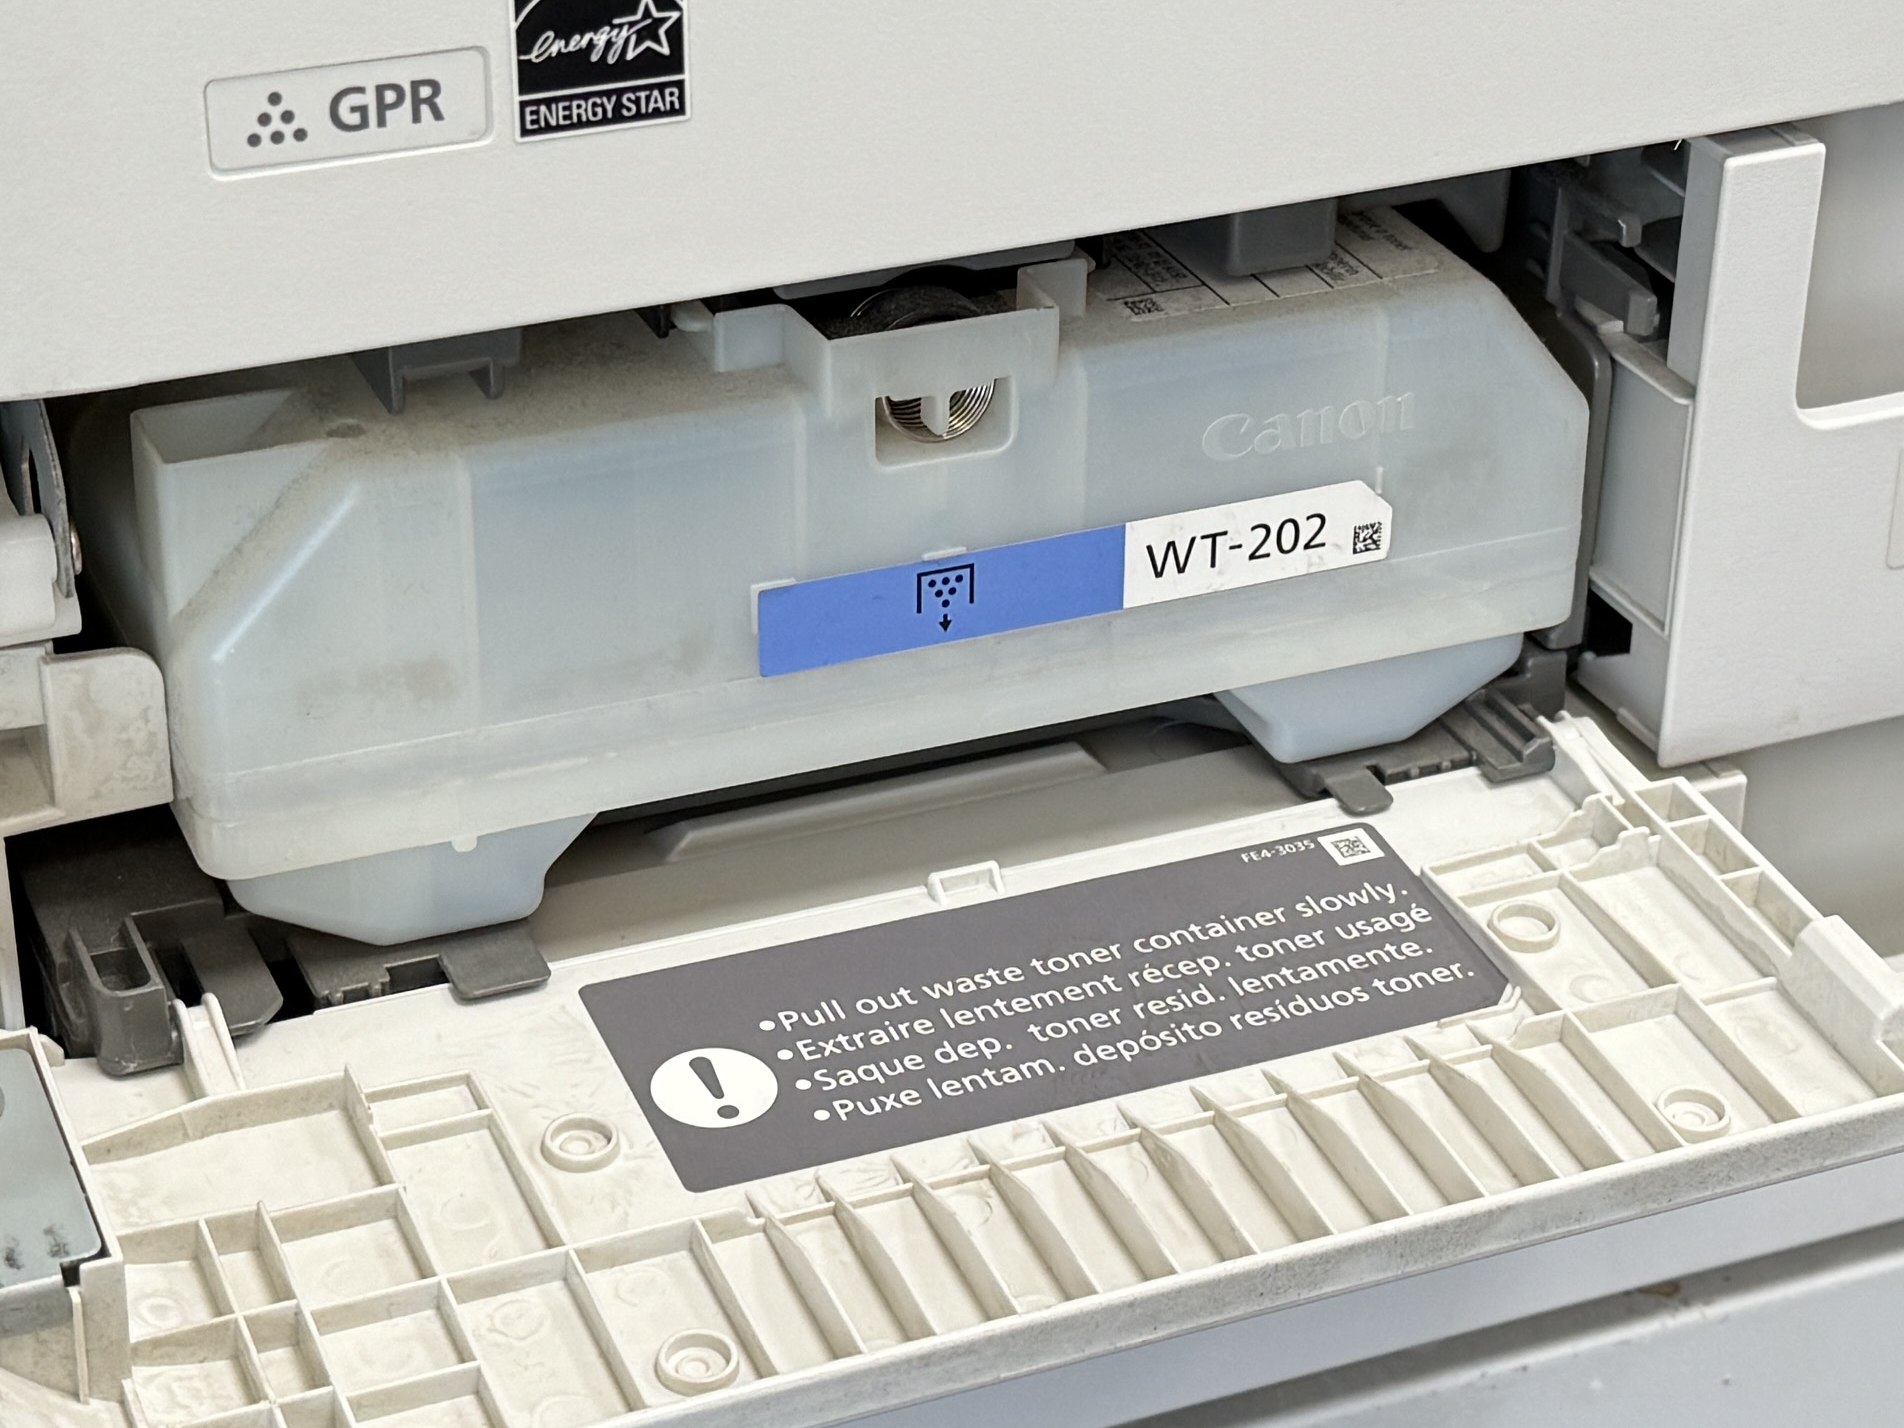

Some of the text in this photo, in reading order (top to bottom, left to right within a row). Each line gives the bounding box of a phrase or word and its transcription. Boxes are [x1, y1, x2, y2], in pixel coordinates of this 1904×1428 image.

[329, 79, 445, 132] GPR
[525, 88, 680, 130] ENERGY STAR
[1202, 392, 1414, 461] Canon
[1147, 513, 1327, 579] WT-202
[1241, 840, 1315, 862] FE4-3035
[856, 987, 918, 1014] out
[922, 966, 1025, 999] waste
[1030, 943, 1121, 975] toner
[1134, 907, 1285, 953] container
[1296, 882, 1407, 917] slowly.
[940, 974, 1122, 1029] lentement
[1128, 953, 1231, 988] récep.
[1235, 929, 1325, 962] toner
[1335, 903, 1432, 939] usagé
[927, 1058, 1066, 1100] lentam.
[1073, 1020, 1222, 1067] depósito
[1229, 984, 1370, 1031] resíduos
[1372, 962, 1475, 996] toner.
[934, 1037, 1013, 1064] dep.
[1028, 1007, 1121, 1042] toner
[1133, 983, 1226, 1019] resid.
[1228, 941, 1432, 996] lentamente.
